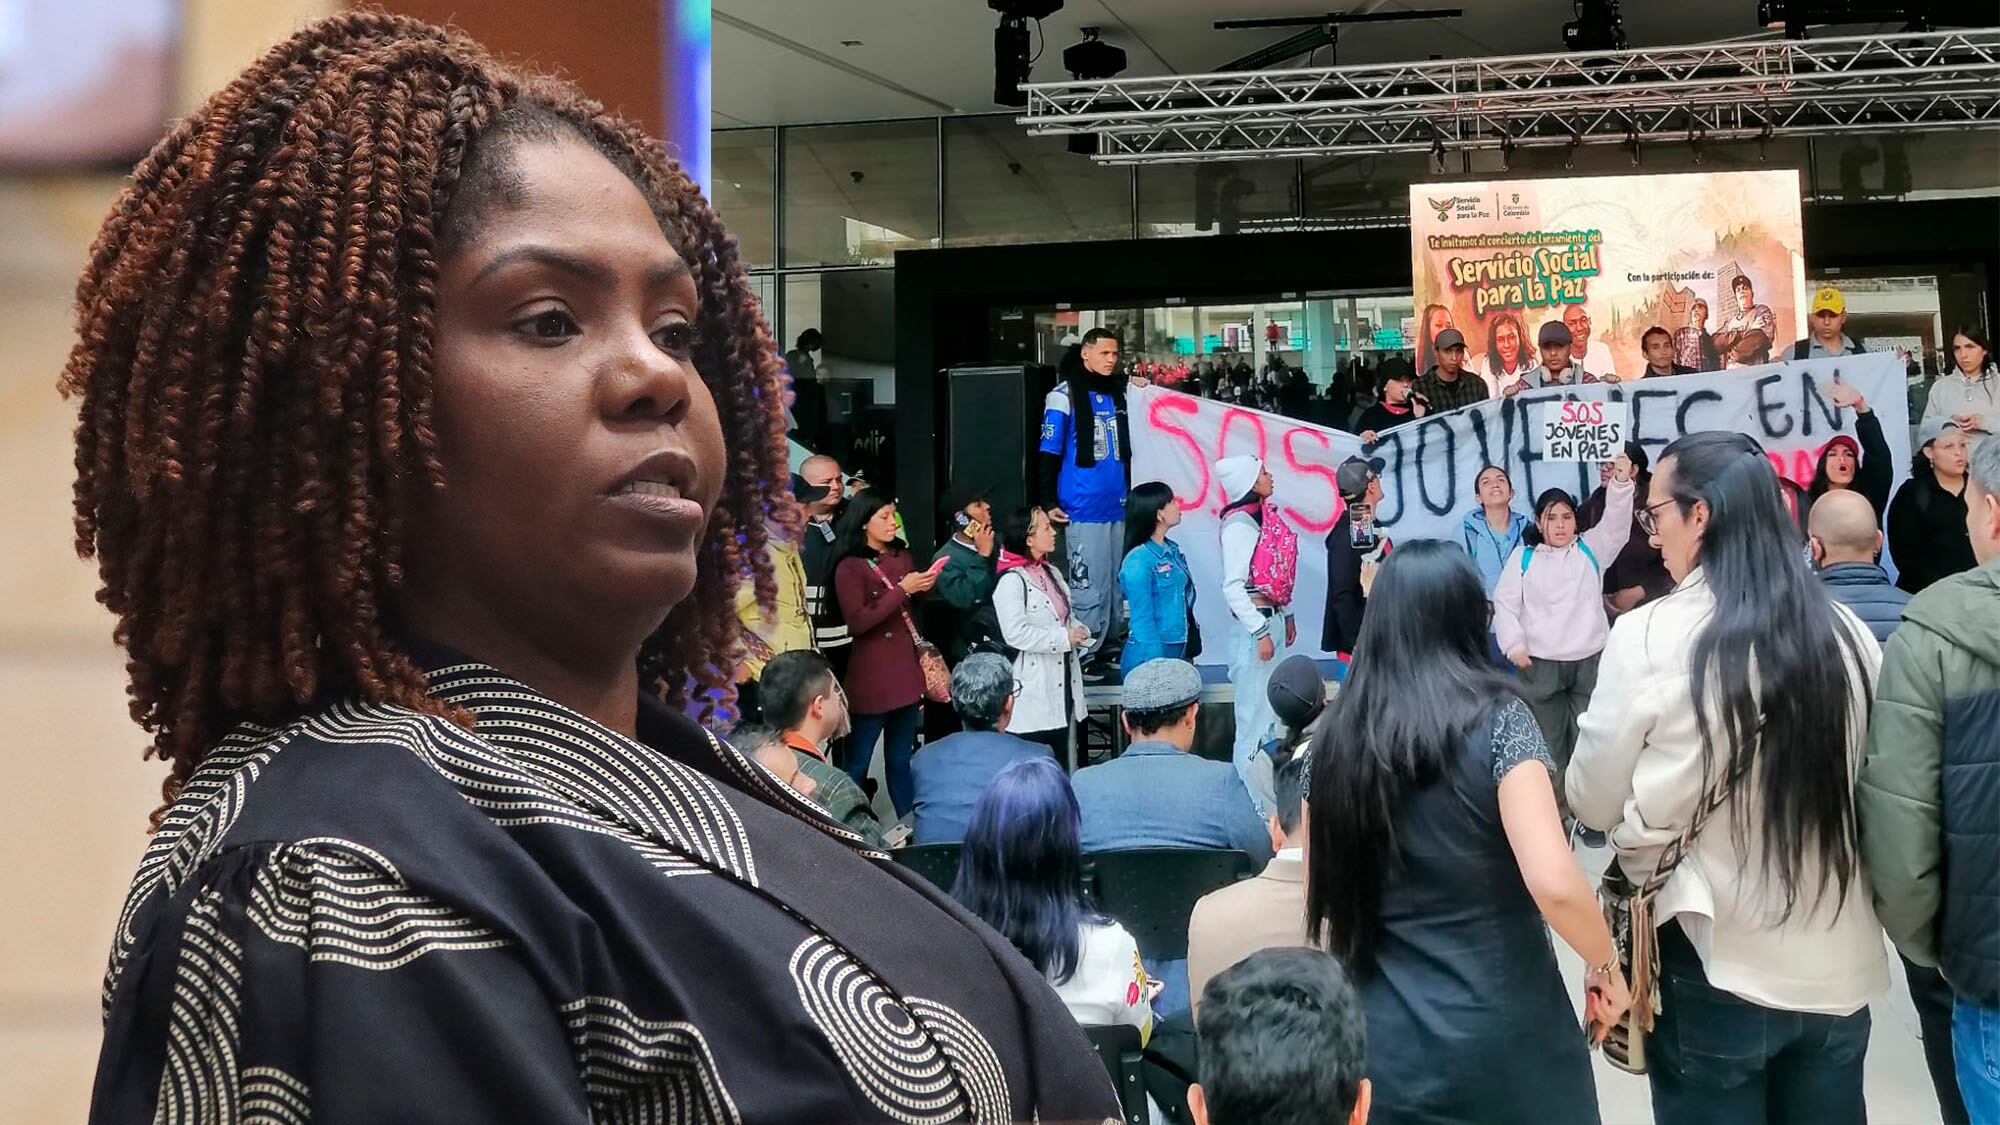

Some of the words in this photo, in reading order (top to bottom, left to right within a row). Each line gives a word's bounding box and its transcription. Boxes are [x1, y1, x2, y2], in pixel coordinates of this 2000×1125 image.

[1429, 237, 1441, 249] Te
[1441, 235, 1477, 248] invitamos
[1478, 235, 1486, 247] al
[1486, 233, 1525, 246] concierto
[1526, 232, 1536, 245] de
[1588, 230, 1600, 242] del
[1451, 252, 1533, 287] Servicio
[1536, 245, 1598, 277] Social
[1627, 272, 1641, 282] Con
[1642, 272, 1650, 281] la
[1651, 271, 1700, 283] participación
[1476, 284, 1523, 315] para
[1527, 279, 1546, 302] la
[1551, 274, 1585, 300] Paz
[1757, 368, 1843, 438] EN
[1545, 422, 1620, 443] JÓVENES
[1552, 441, 1572, 459] EN
[1578, 440, 1612, 462] PAZ
